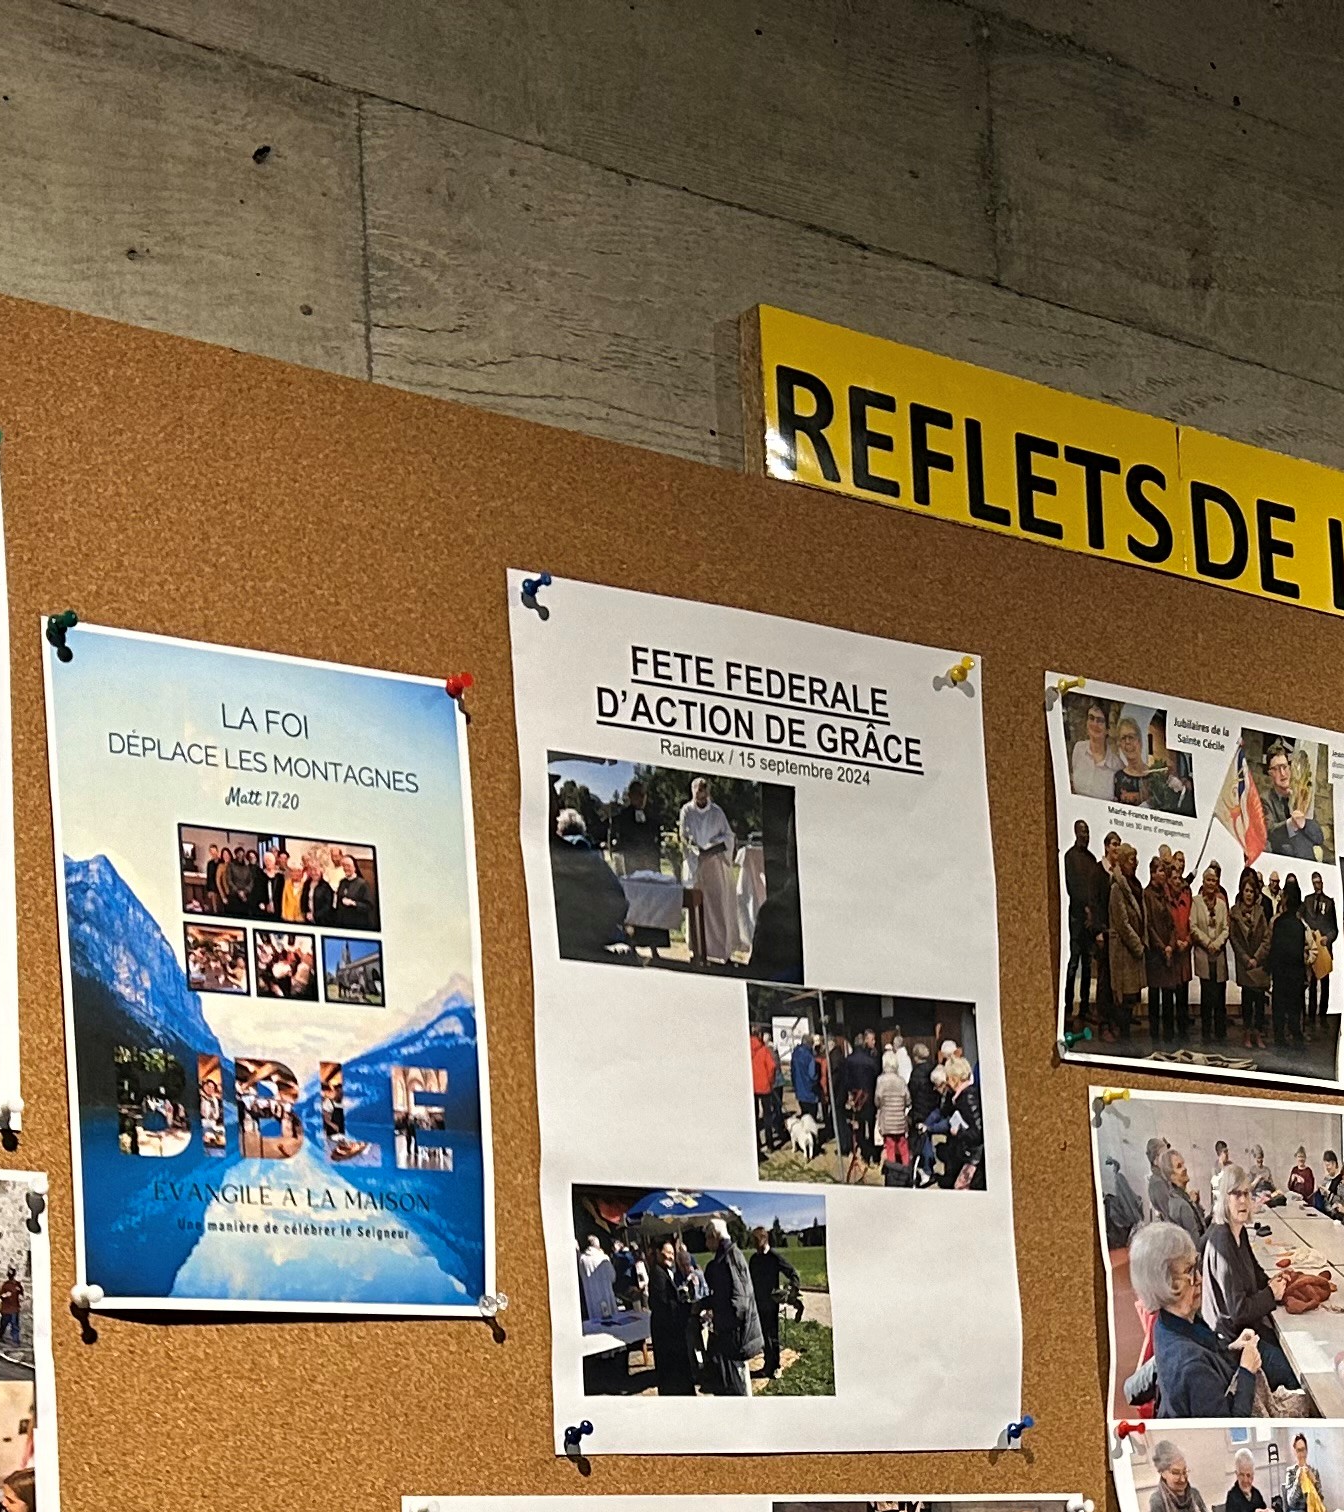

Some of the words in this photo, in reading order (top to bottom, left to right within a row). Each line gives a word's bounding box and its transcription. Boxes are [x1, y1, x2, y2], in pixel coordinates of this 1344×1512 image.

[774, 364, 1175, 566] REFLETS
[1190, 480, 1301, 600] DE
[631, 645, 716, 689] FETE
[725, 660, 889, 719] FEDERALE
[220, 702, 259, 733] LA
[264, 709, 310, 740] FOI
[595, 685, 755, 741] D’ACTION
[765, 713, 808, 749] DE
[816, 721, 923, 768] GRÂCE
[1173, 717, 1210, 733] Jubilaires
[1210, 725, 1221, 736] de
[1222, 726, 1230, 737] la
[1177, 733, 1201, 748] Sainte
[1202, 738, 1225, 751] Cécile
[108, 728, 219, 768] DÉPLACE
[224, 747, 268, 774] LES
[273, 754, 420, 794] MONTAGNES
[659, 737, 725, 765] Raimeux
[728, 749, 735, 766] /
[739, 750, 757, 769] 15
[759, 754, 834, 781] septembre
[837, 766, 871, 786] 2024
[224, 786, 262, 808] Matt
[265, 790, 300, 811] 17:20
[113, 1047, 454, 1173] BIBLE
[306, 1186, 337, 1210] LA
[344, 1189, 432, 1214] MAISON
[177, 1216, 204, 1233] Une
[207, 1218, 259, 1235] manière
[263, 1221, 280, 1236] de
[283, 1221, 337, 1238] célébrer
[340, 1223, 353, 1239] le
[356, 1225, 411, 1243] Seigneur
